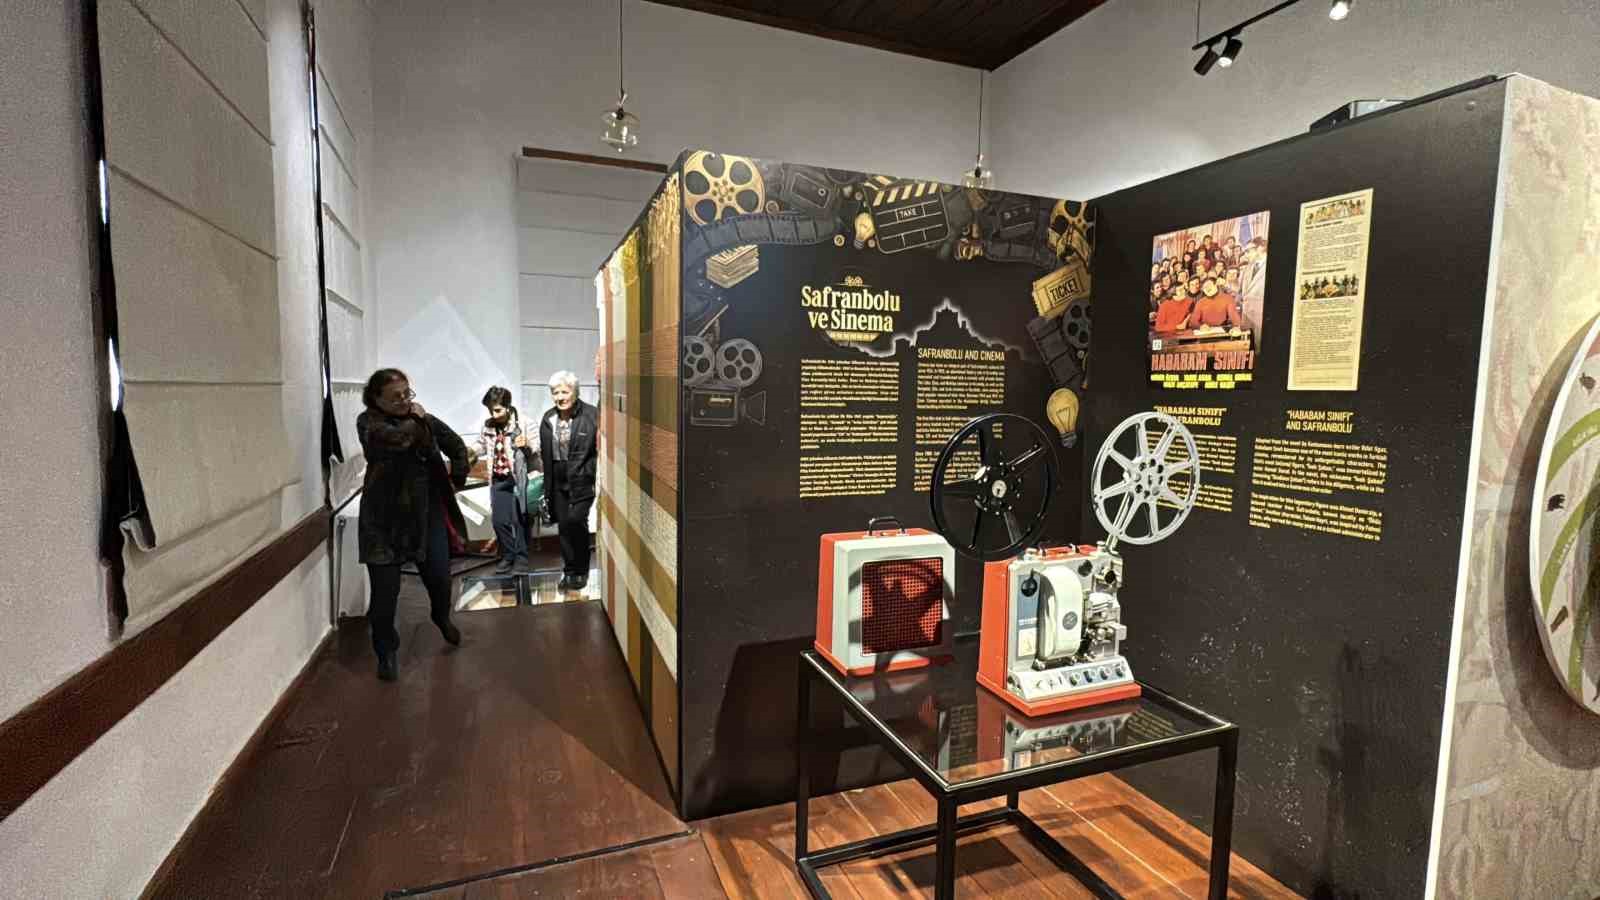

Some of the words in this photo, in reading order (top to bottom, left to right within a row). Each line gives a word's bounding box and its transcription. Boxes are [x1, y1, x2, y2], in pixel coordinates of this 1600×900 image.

[899, 208, 917, 219] TAKE
[801, 285, 900, 312] Safranbolu
[1050, 278, 1079, 302] TICKET
[808, 311, 829, 329] ve
[830, 308, 893, 332] Sinema
[918, 347, 963, 360] SAFRANBOLU
[964, 350, 979, 361] AND
[980, 350, 1005, 361] CINEMA
[1151, 351, 1208, 371] HABABAM
[1213, 350, 1255, 370] SINIFI
[1285, 420, 1301, 430] AND
[1302, 421, 1353, 433] SAFRANBOLU
